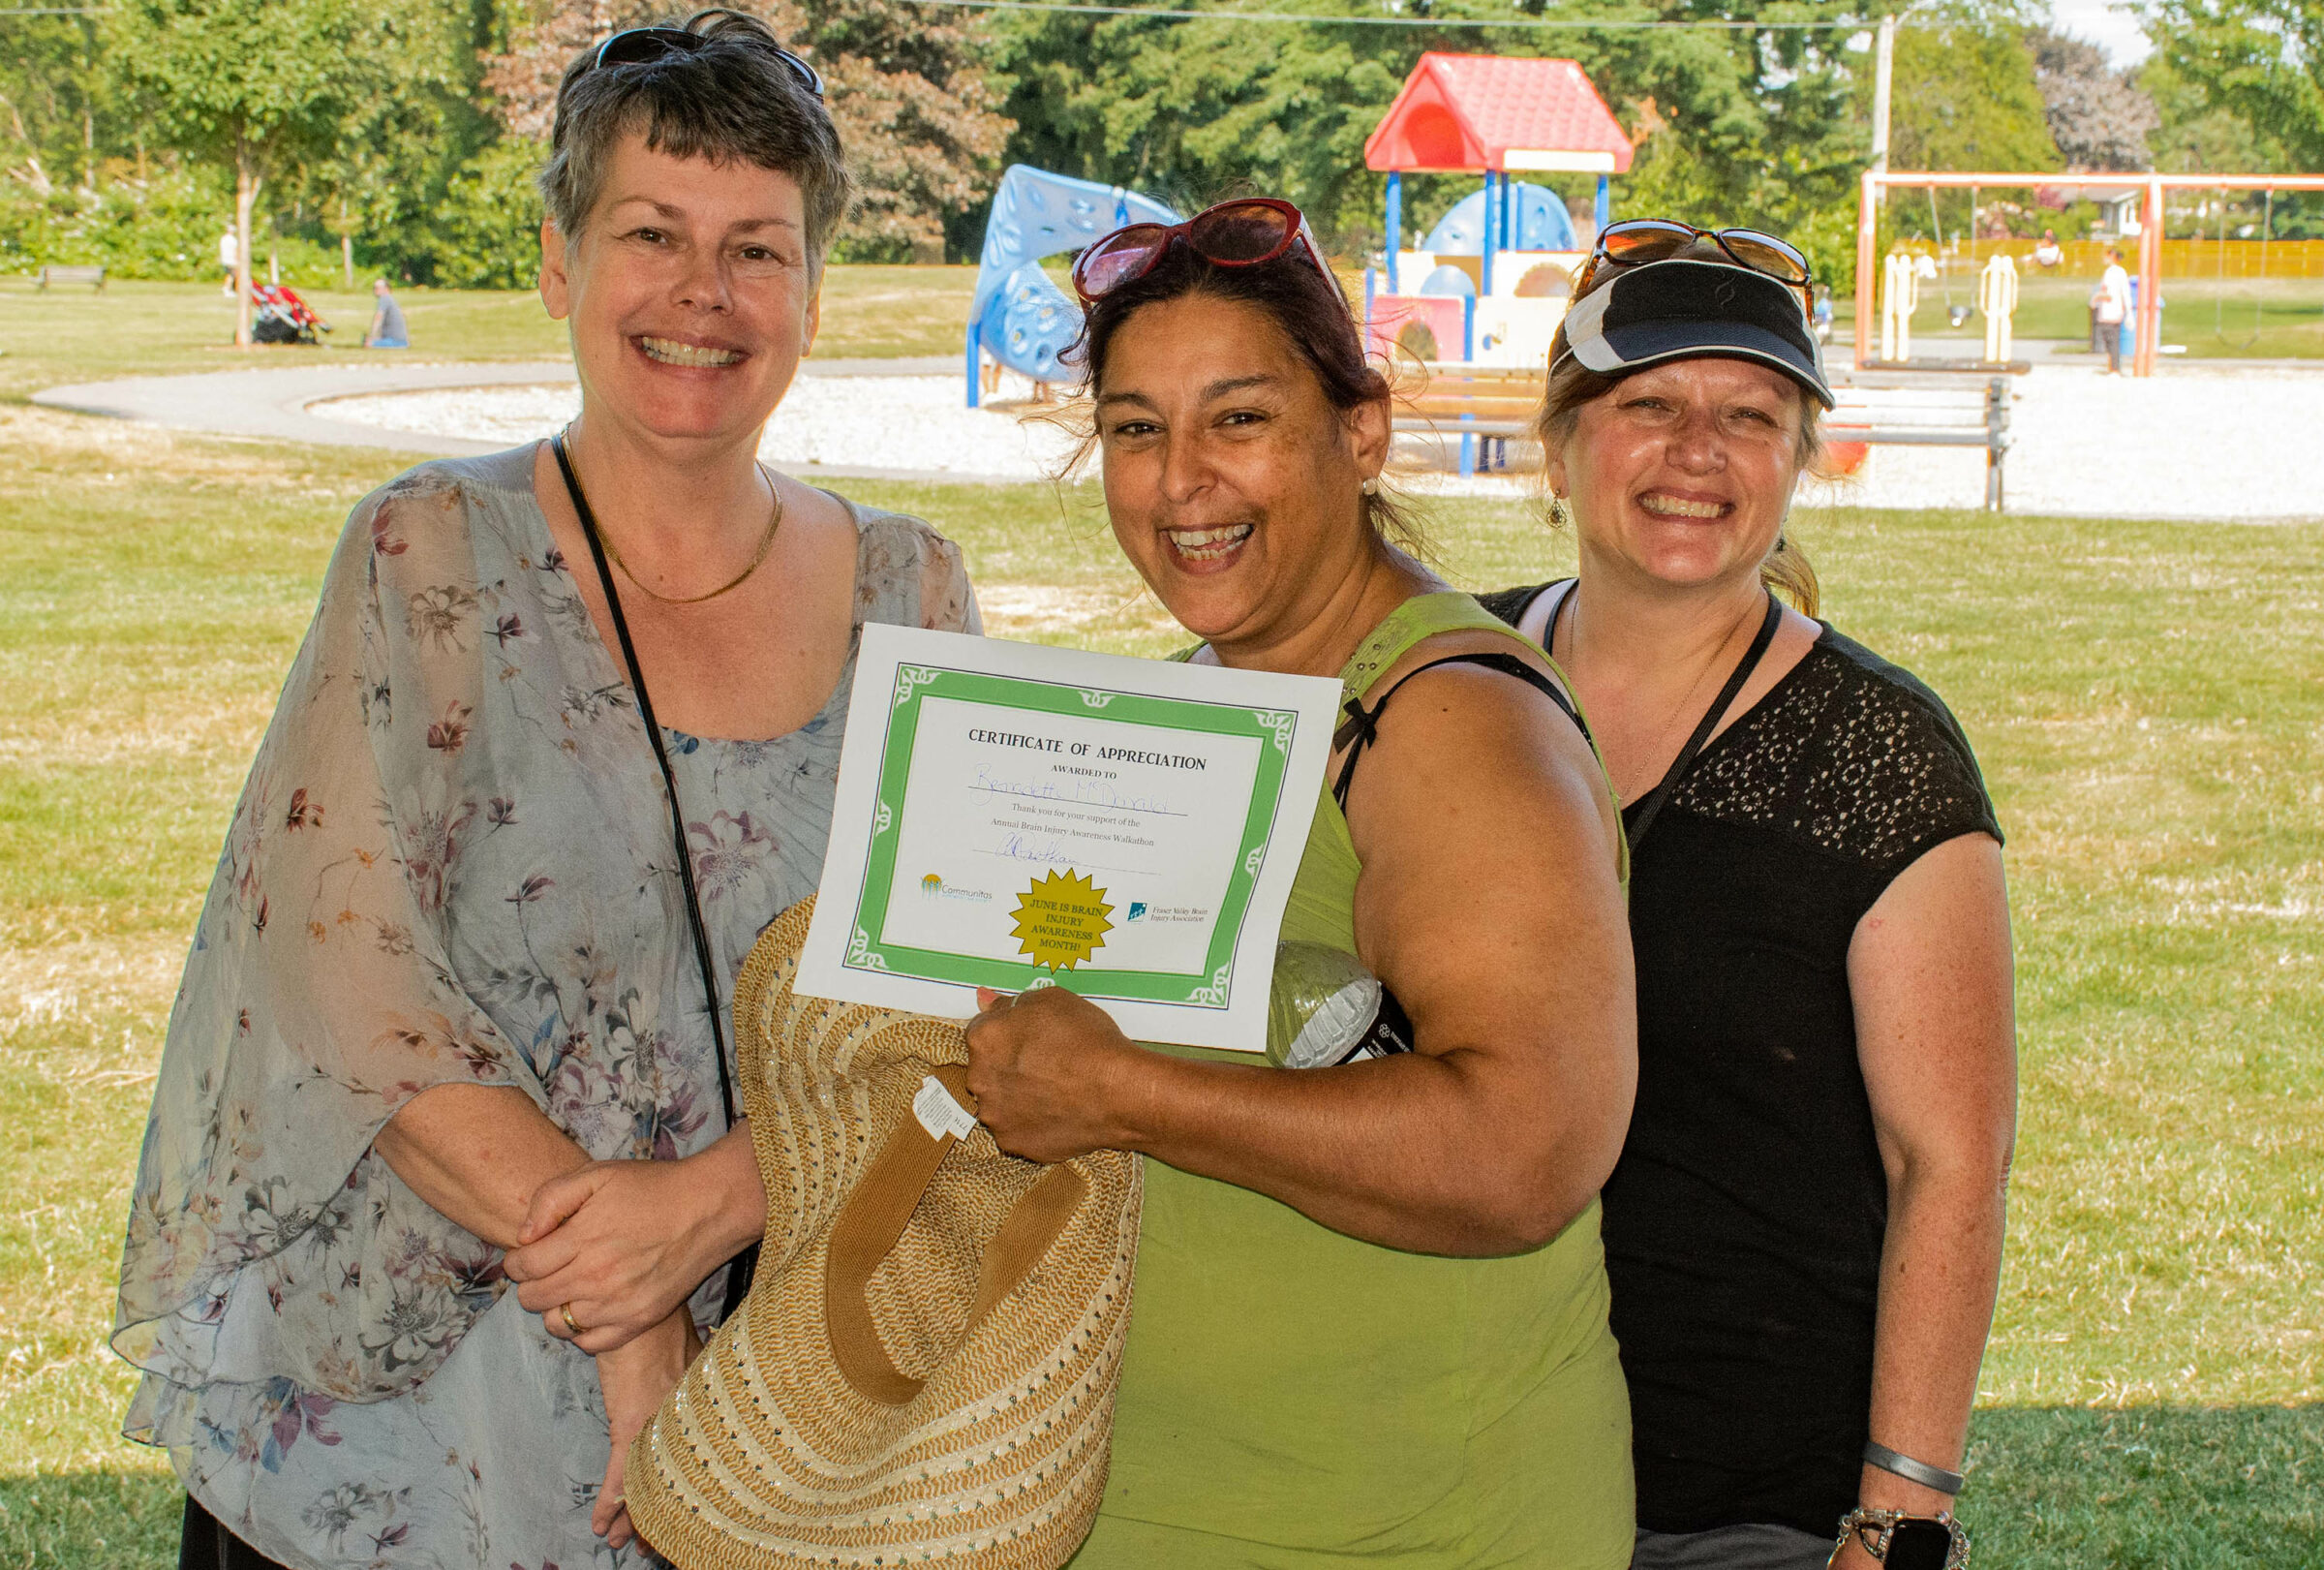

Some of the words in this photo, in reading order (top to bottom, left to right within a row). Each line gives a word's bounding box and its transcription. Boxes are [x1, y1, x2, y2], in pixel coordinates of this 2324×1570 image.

[968, 728, 1063, 753] CERTIFICATE
[1070, 742, 1090, 756] OF
[1096, 747, 1207, 771] APPRECIATION
[1051, 764, 1102, 778] AWARDED
[1103, 770, 1117, 780] TO
[1012, 803, 1036, 814] Thank
[1037, 809, 1053, 818] you
[1054, 808, 1065, 817] for
[1067, 812, 1085, 823] your
[1086, 815, 1116, 825] support
[1117, 816, 1128, 826] of
[1127, 818, 1141, 828] the
[991, 817, 1019, 829] Annual
[1021, 821, 1042, 833] Brain
[1044, 824, 1069, 837] Injury
[1070, 829, 1112, 841] Awareness
[1113, 834, 1154, 847] Walkathon
[942, 884, 993, 900] Communitas
[1029, 899, 1057, 911] JUNE
[1059, 903, 1069, 912] IS
[1071, 905, 1104, 917] BRAIN
[1046, 913, 1084, 927] INJURY
[1030, 924, 1093, 940] AWARENESS
[1039, 938, 1082, 952] MONTH!
